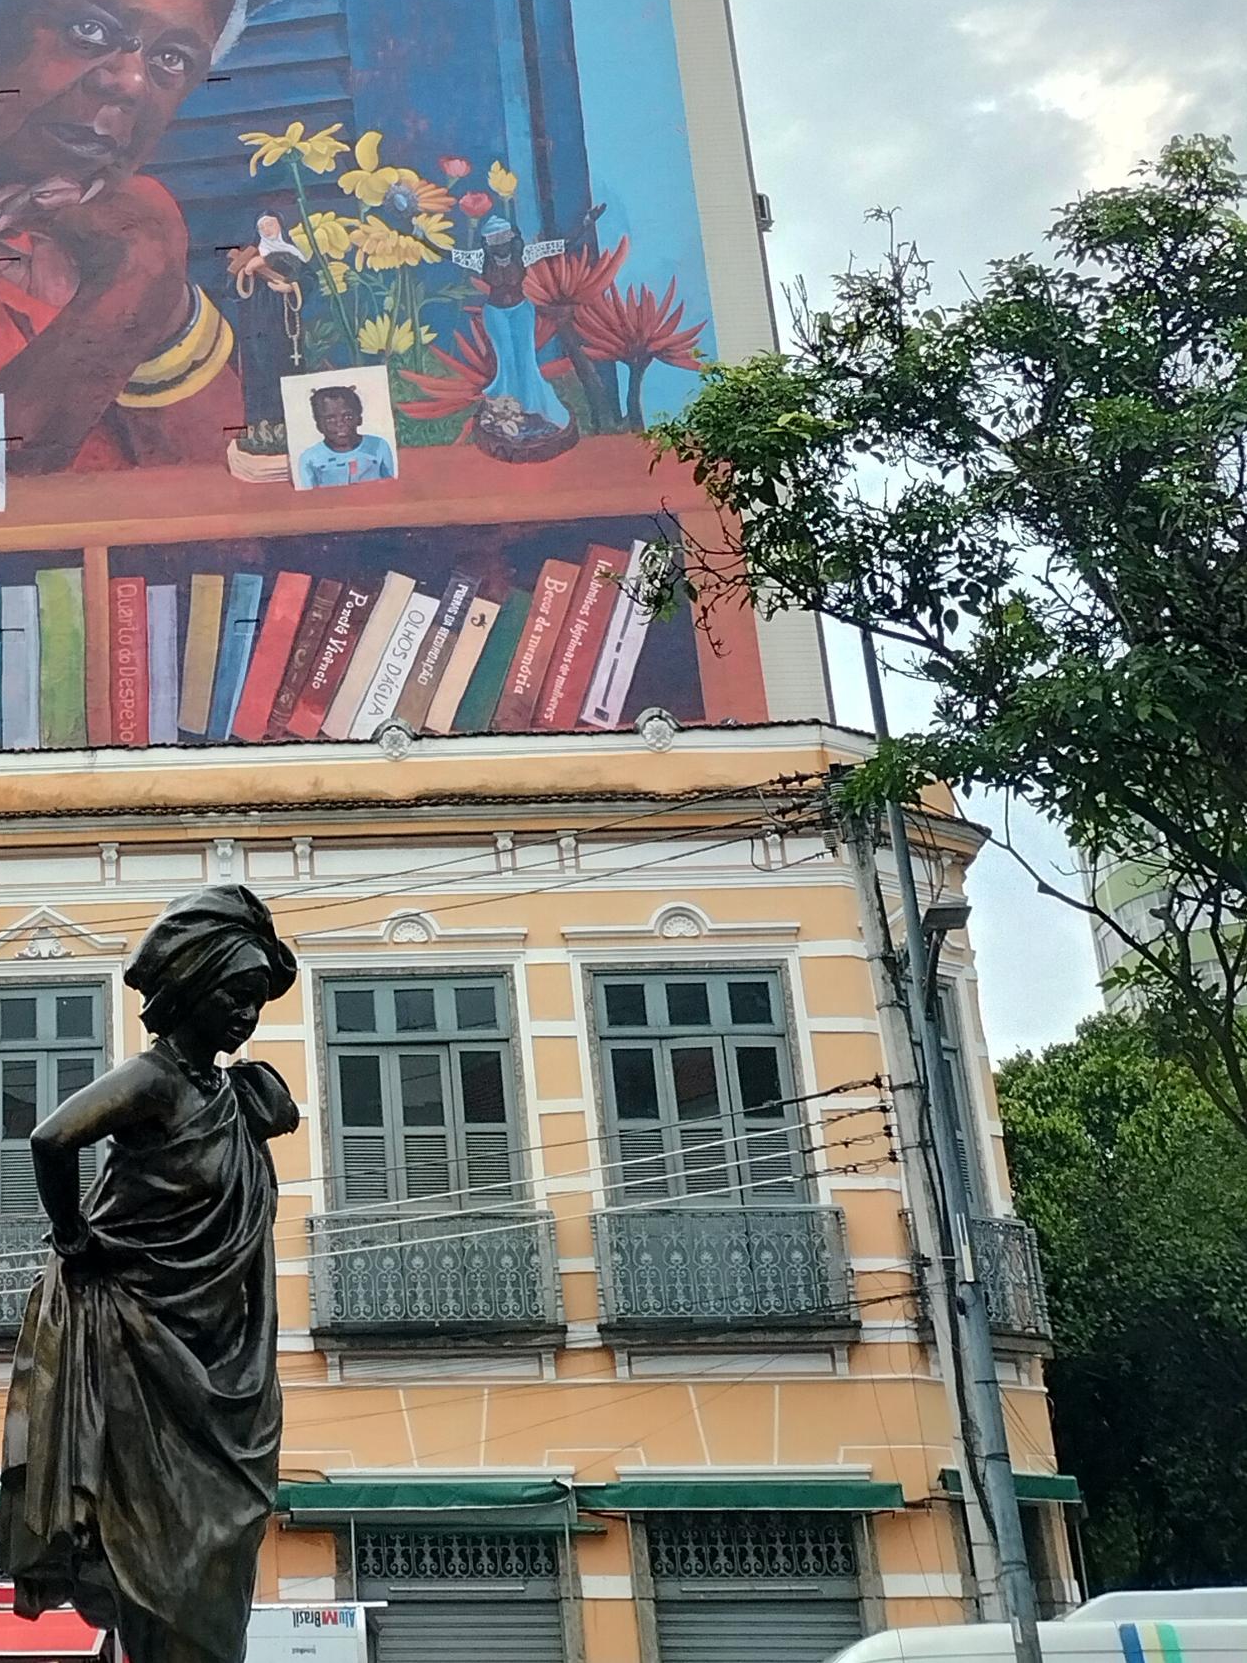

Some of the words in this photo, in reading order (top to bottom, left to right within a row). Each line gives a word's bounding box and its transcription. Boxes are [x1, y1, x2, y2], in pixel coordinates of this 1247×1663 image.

[116, 584, 138, 645] Quarto
[539, 576, 568, 615] Becos
[392, 609, 425, 661] OLHOS
[533, 617, 551, 632] da
[119, 648, 135, 663] do
[514, 634, 541, 695] memória
[119, 667, 138, 742] Despejo
